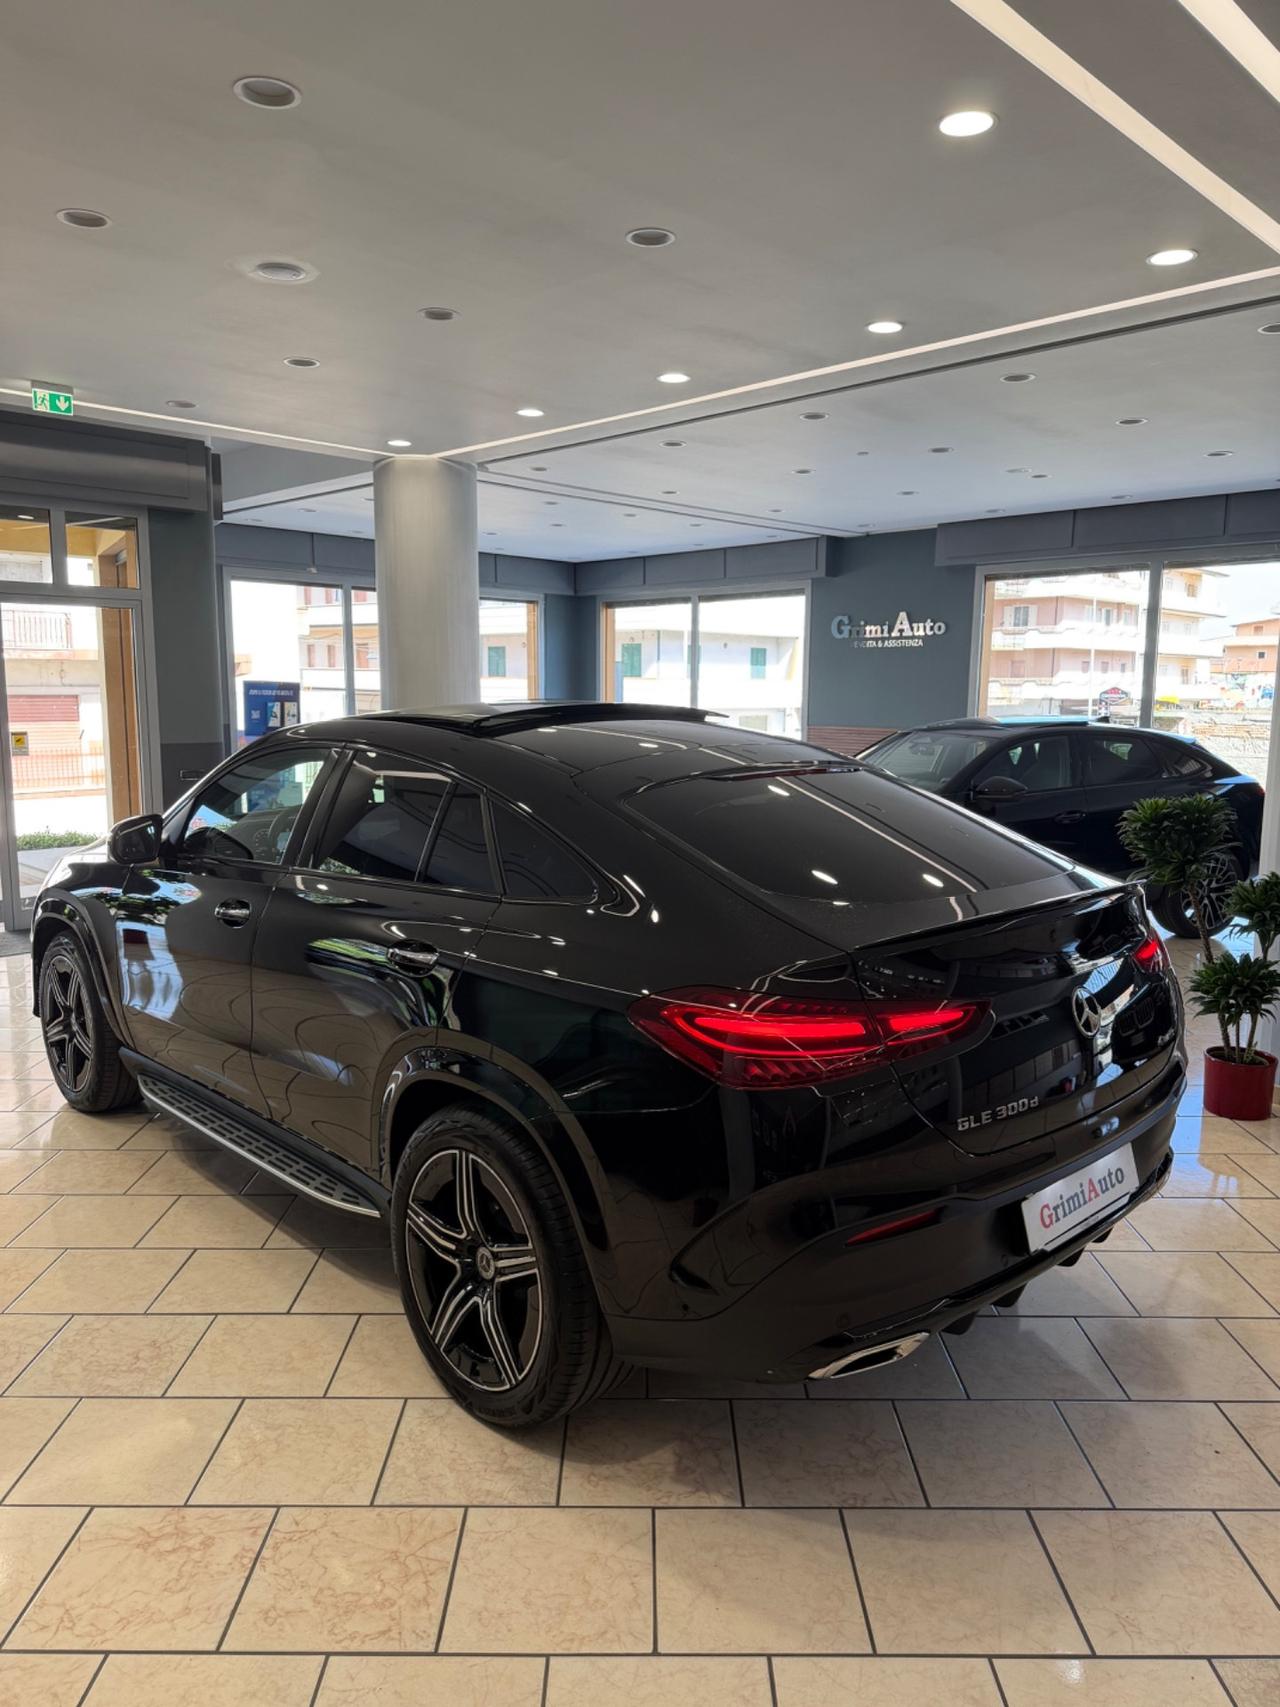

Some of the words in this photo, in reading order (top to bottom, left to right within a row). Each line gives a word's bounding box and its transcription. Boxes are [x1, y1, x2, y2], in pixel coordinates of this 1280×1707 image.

[877, 640, 883, 648] &
[883, 638, 924, 648] ASSISTENZA
[957, 1111, 993, 1132] GLE
[1039, 1167, 1125, 1228] GrimiAuto
